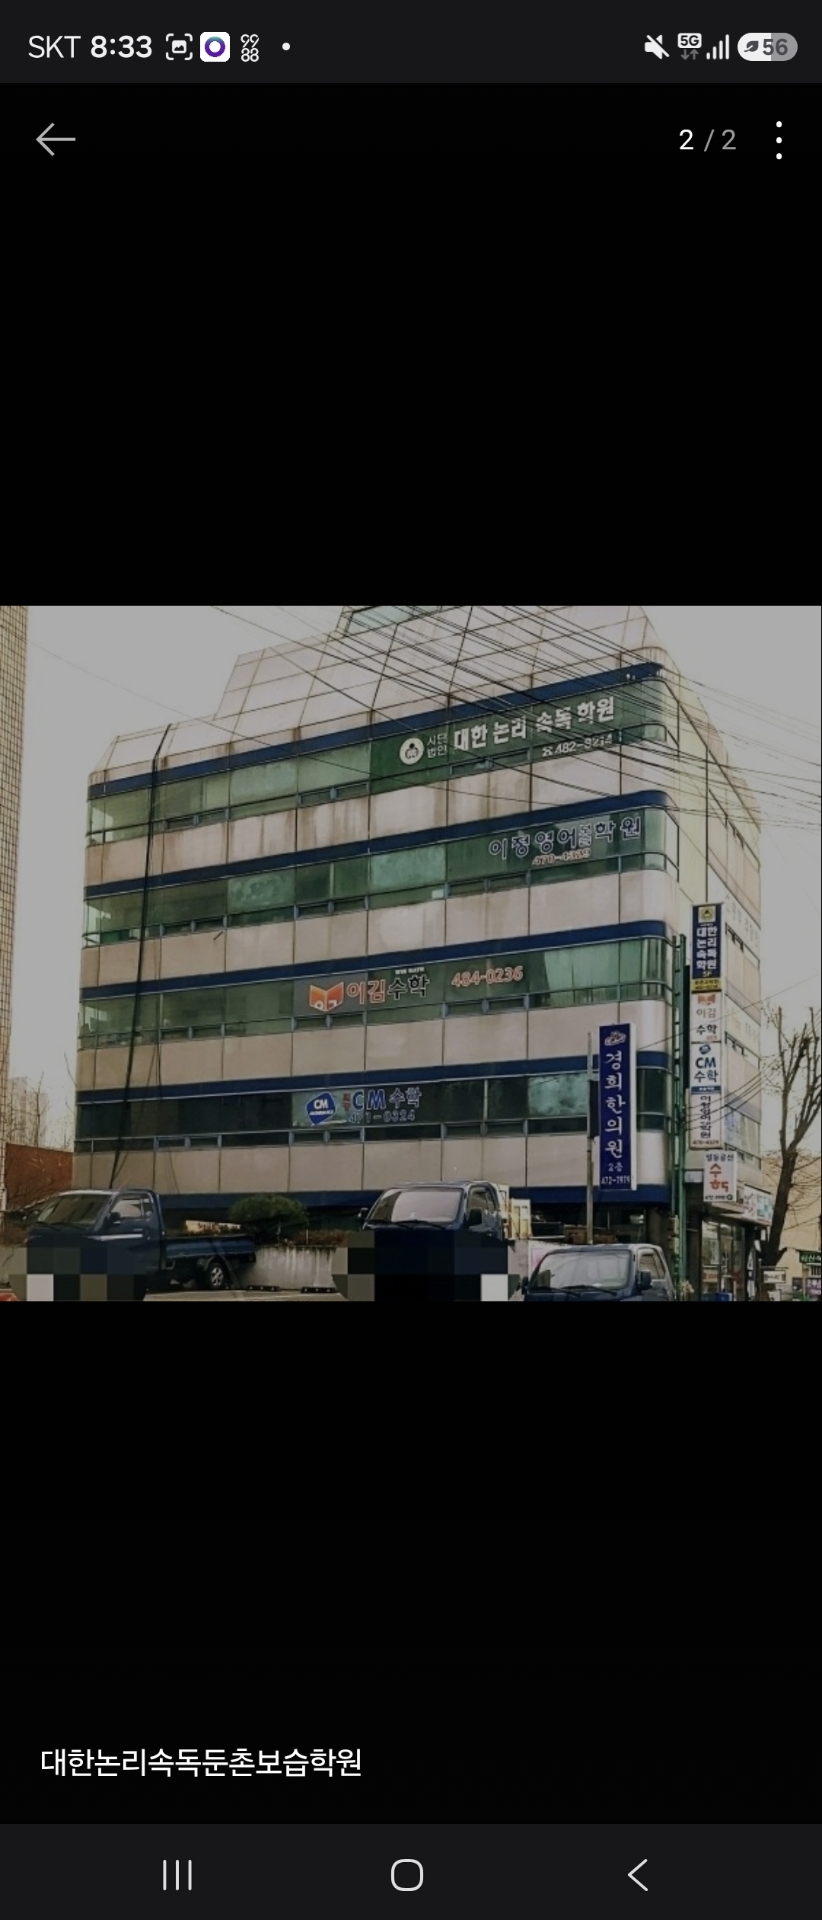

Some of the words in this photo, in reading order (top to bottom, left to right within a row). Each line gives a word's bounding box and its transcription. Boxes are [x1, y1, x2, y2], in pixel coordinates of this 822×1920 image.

[453, 724, 488, 750] 대한
[492, 715, 527, 744] 논리
[577, 696, 614, 724] 학원
[696, 926, 717, 938] 대한
[451, 966, 524, 988] 484-0236
[696, 1008, 717, 1019] 이김
[695, 1024, 717, 1035] 수학
[695, 1057, 716, 1069] CM
[693, 1070, 718, 1083] 수학
[604, 1050, 627, 1159] 경희한의원
